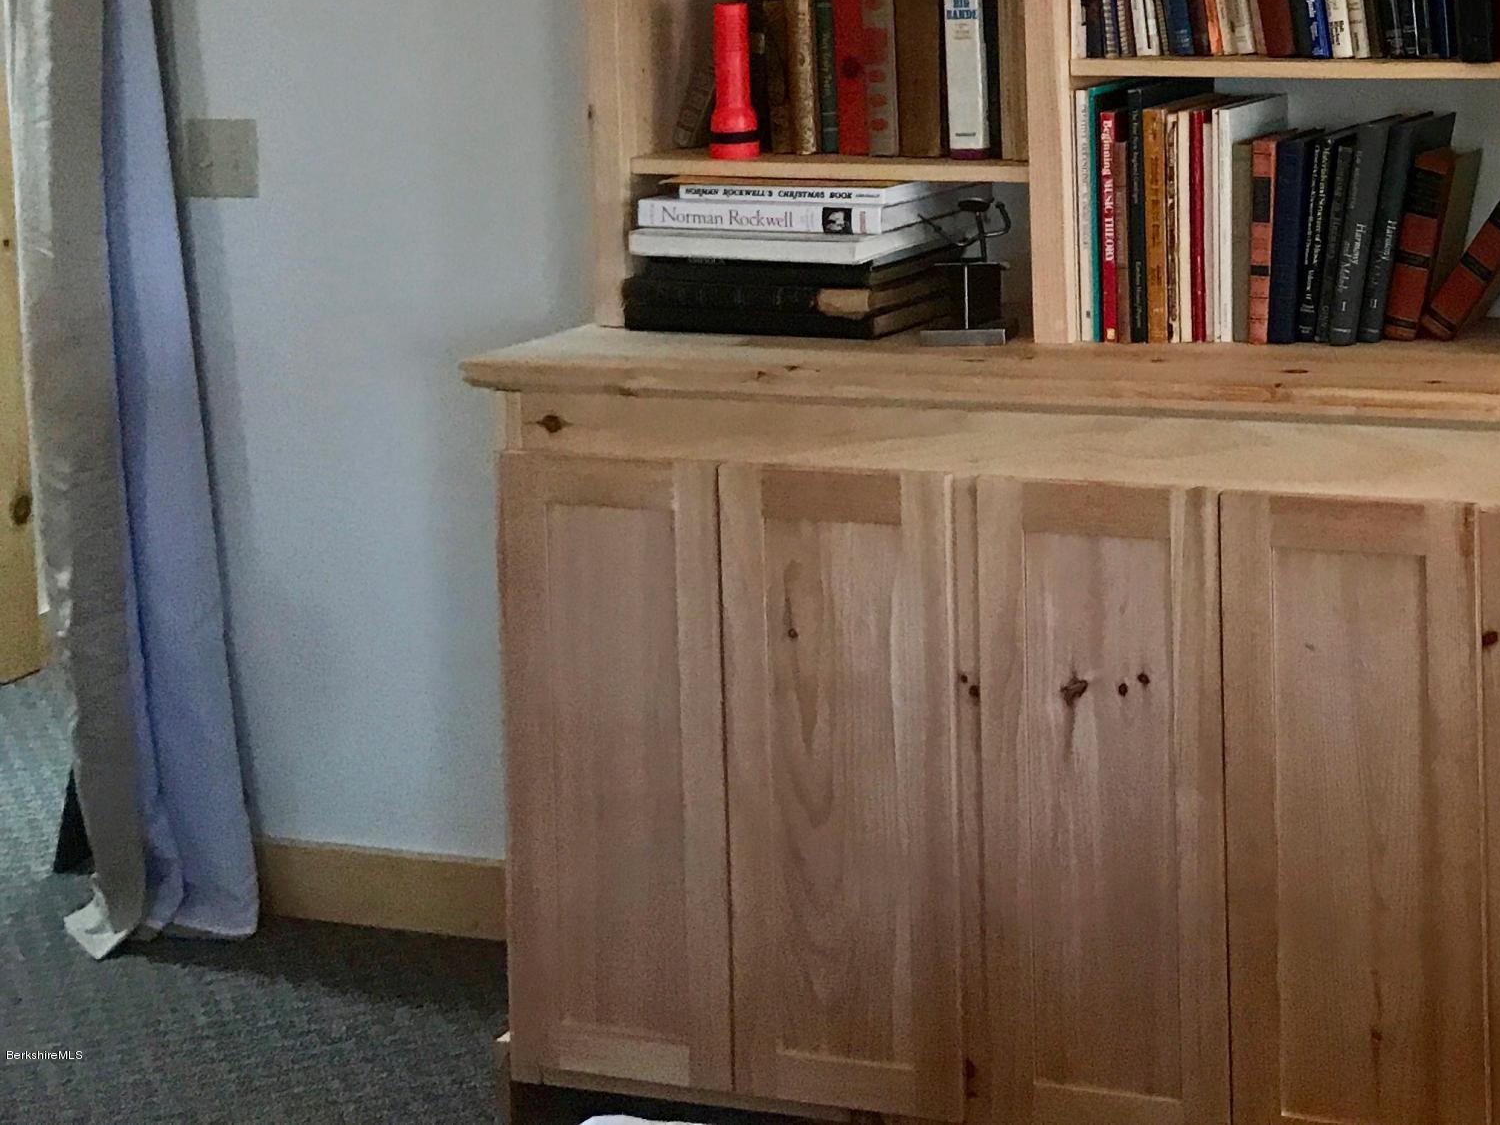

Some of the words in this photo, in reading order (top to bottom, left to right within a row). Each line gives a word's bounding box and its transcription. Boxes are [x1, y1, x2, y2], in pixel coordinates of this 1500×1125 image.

[946, 9, 977, 20] BANDS
[1101, 120, 1114, 176] Beginning
[685, 188, 719, 196] NORMAN
[722, 188, 774, 198] ROCKWELL'S
[778, 190, 825, 200] CHRISTMAS
[1103, 178, 1115, 214] MUSIC
[661, 206, 724, 226] Norman
[729, 209, 793, 228] Rockwell
[1103, 217, 1115, 261] THEORY
[1352, 222, 1367, 265] Harmony
[1381, 219, 1398, 262] Harmony
